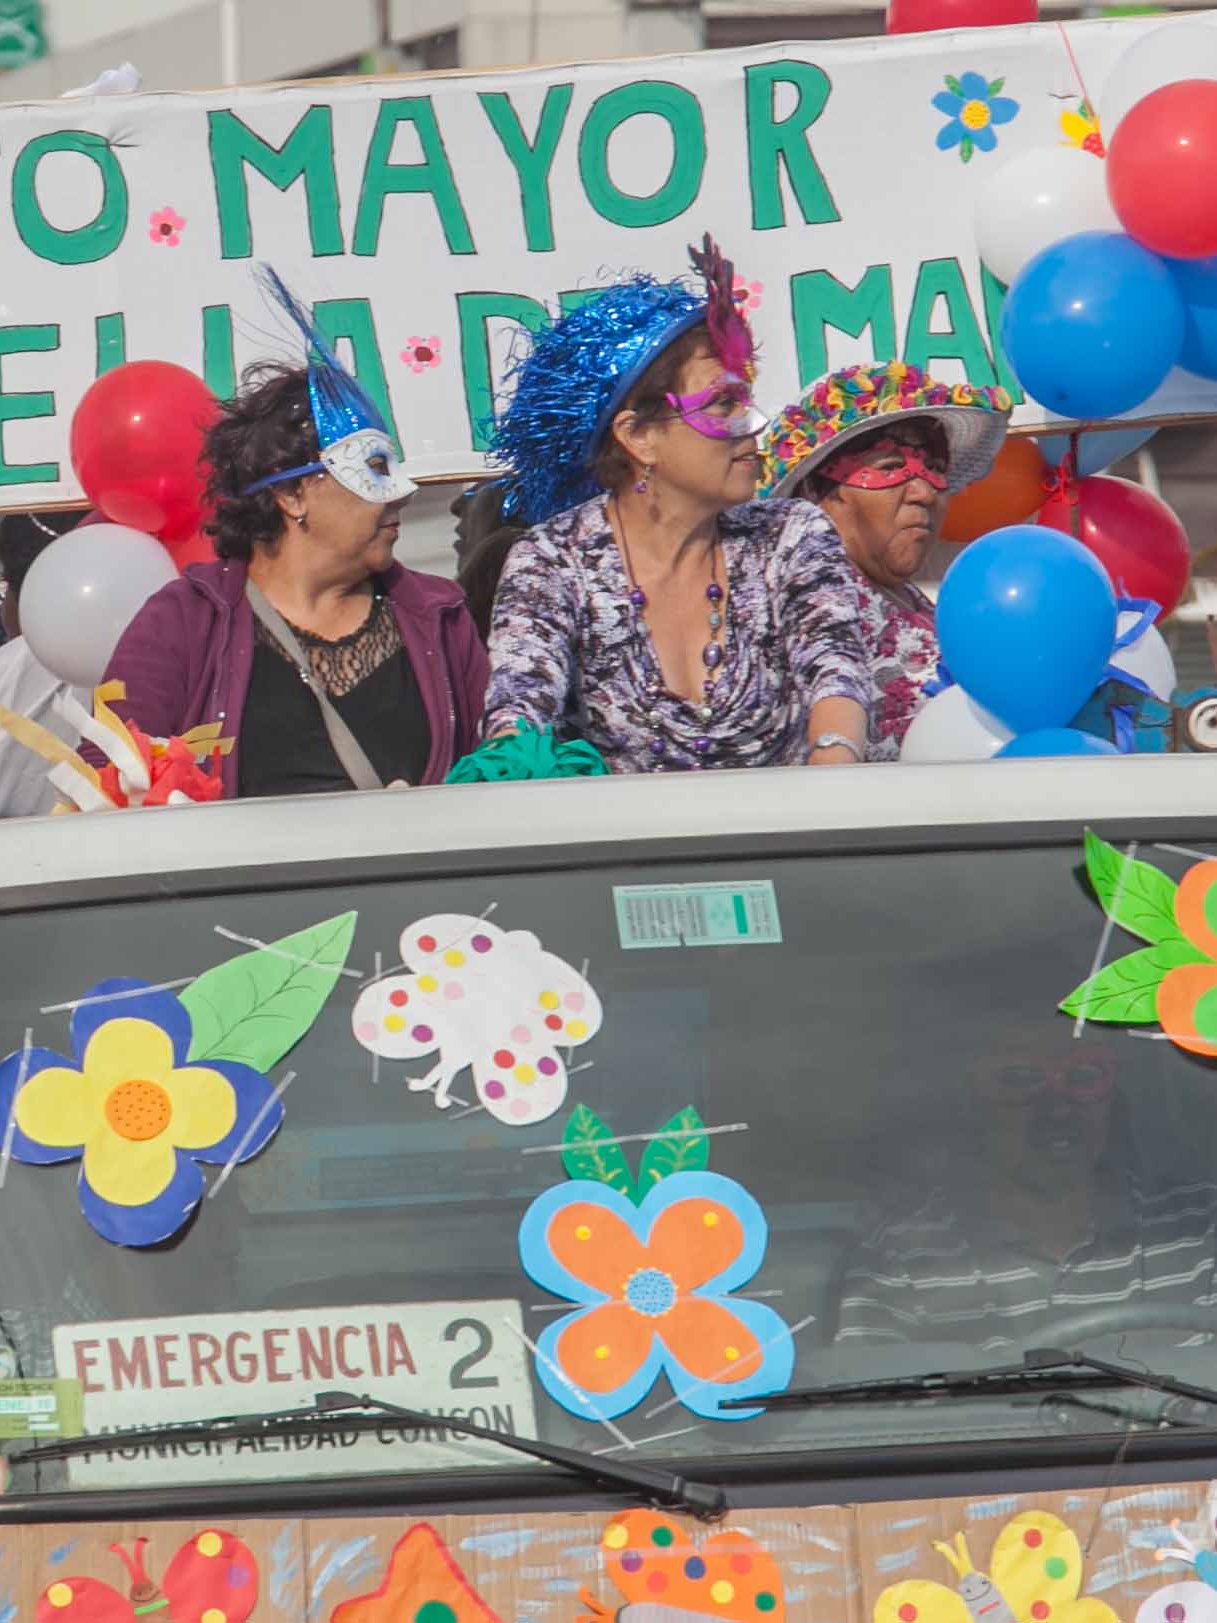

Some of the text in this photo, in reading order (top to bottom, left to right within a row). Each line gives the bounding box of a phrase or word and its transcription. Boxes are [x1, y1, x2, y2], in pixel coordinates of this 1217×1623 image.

[208, 58, 842, 259] MAYOR
[455, 287, 617, 452] D
[73, 1317, 501, 1393] EMERGENCIA 2
